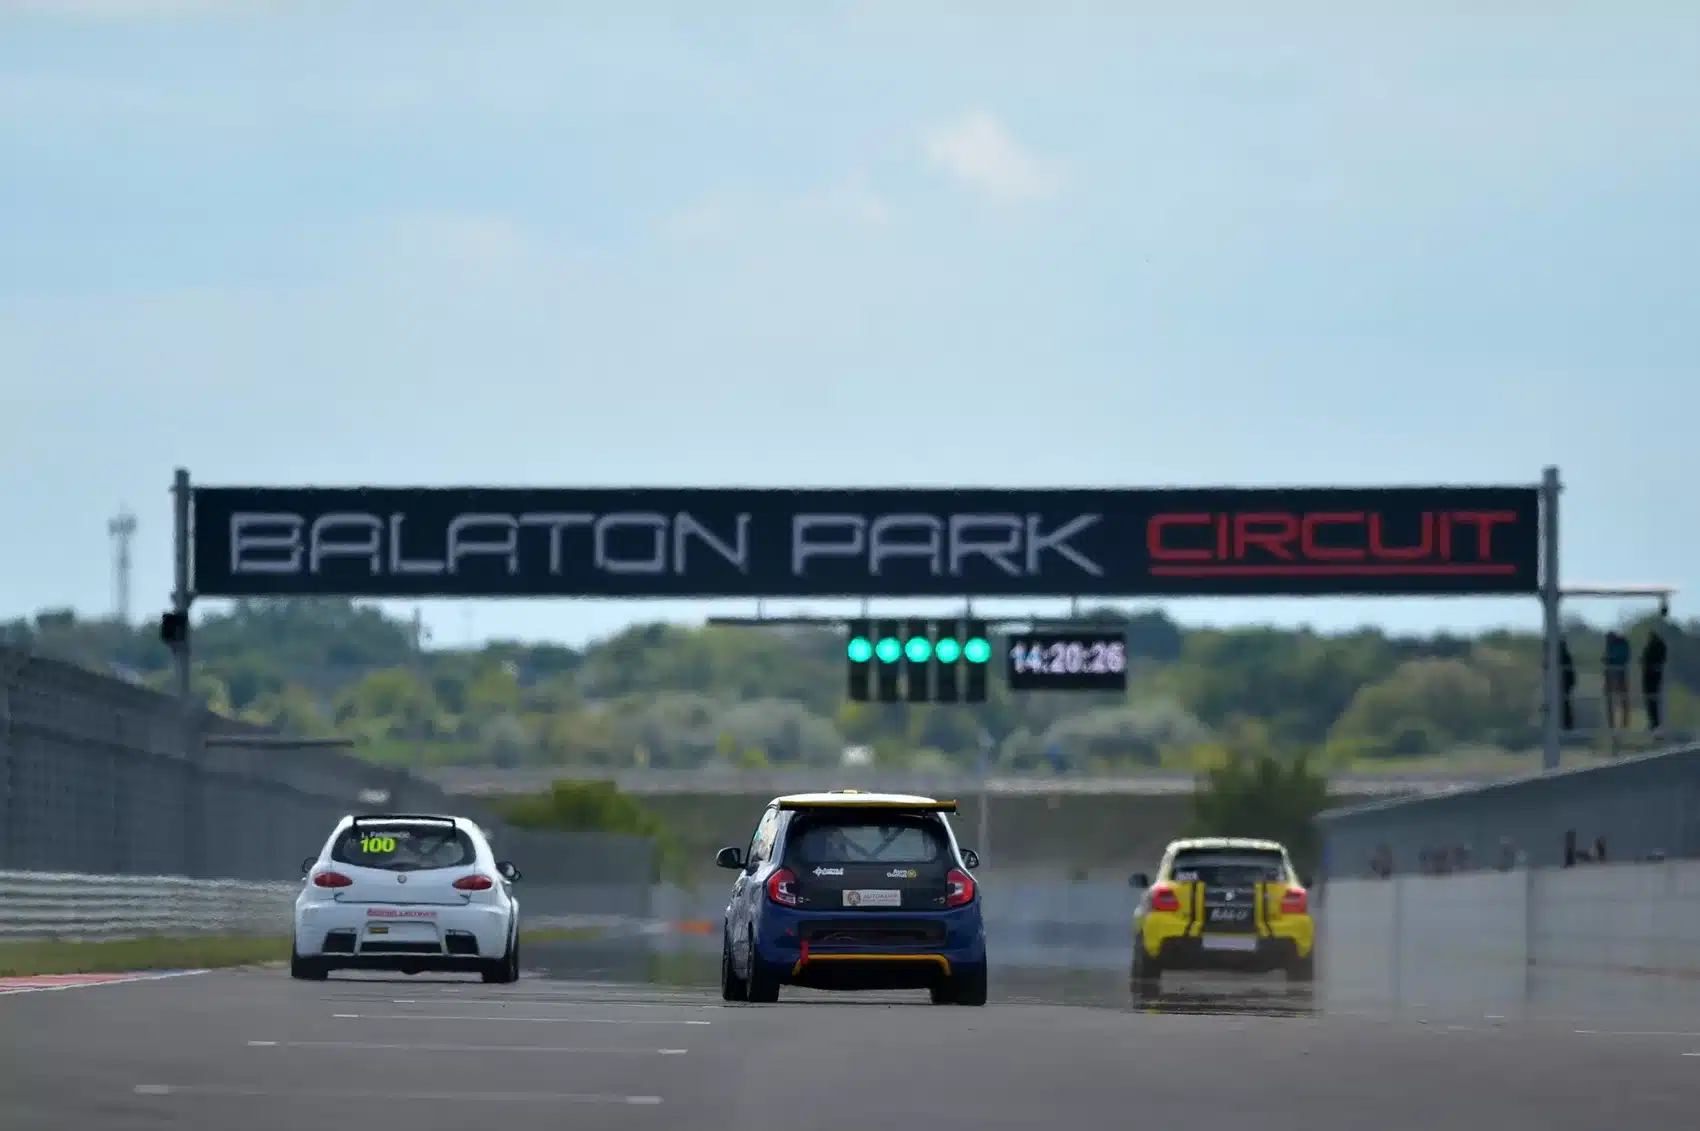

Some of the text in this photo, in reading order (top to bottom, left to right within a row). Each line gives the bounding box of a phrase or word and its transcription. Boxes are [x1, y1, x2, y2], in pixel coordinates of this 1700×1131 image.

[230, 511, 1516, 575] BALATON PARK CIRCUIT
[1010, 640, 1126, 674] 14:20:26
[360, 837, 396, 853] 100
